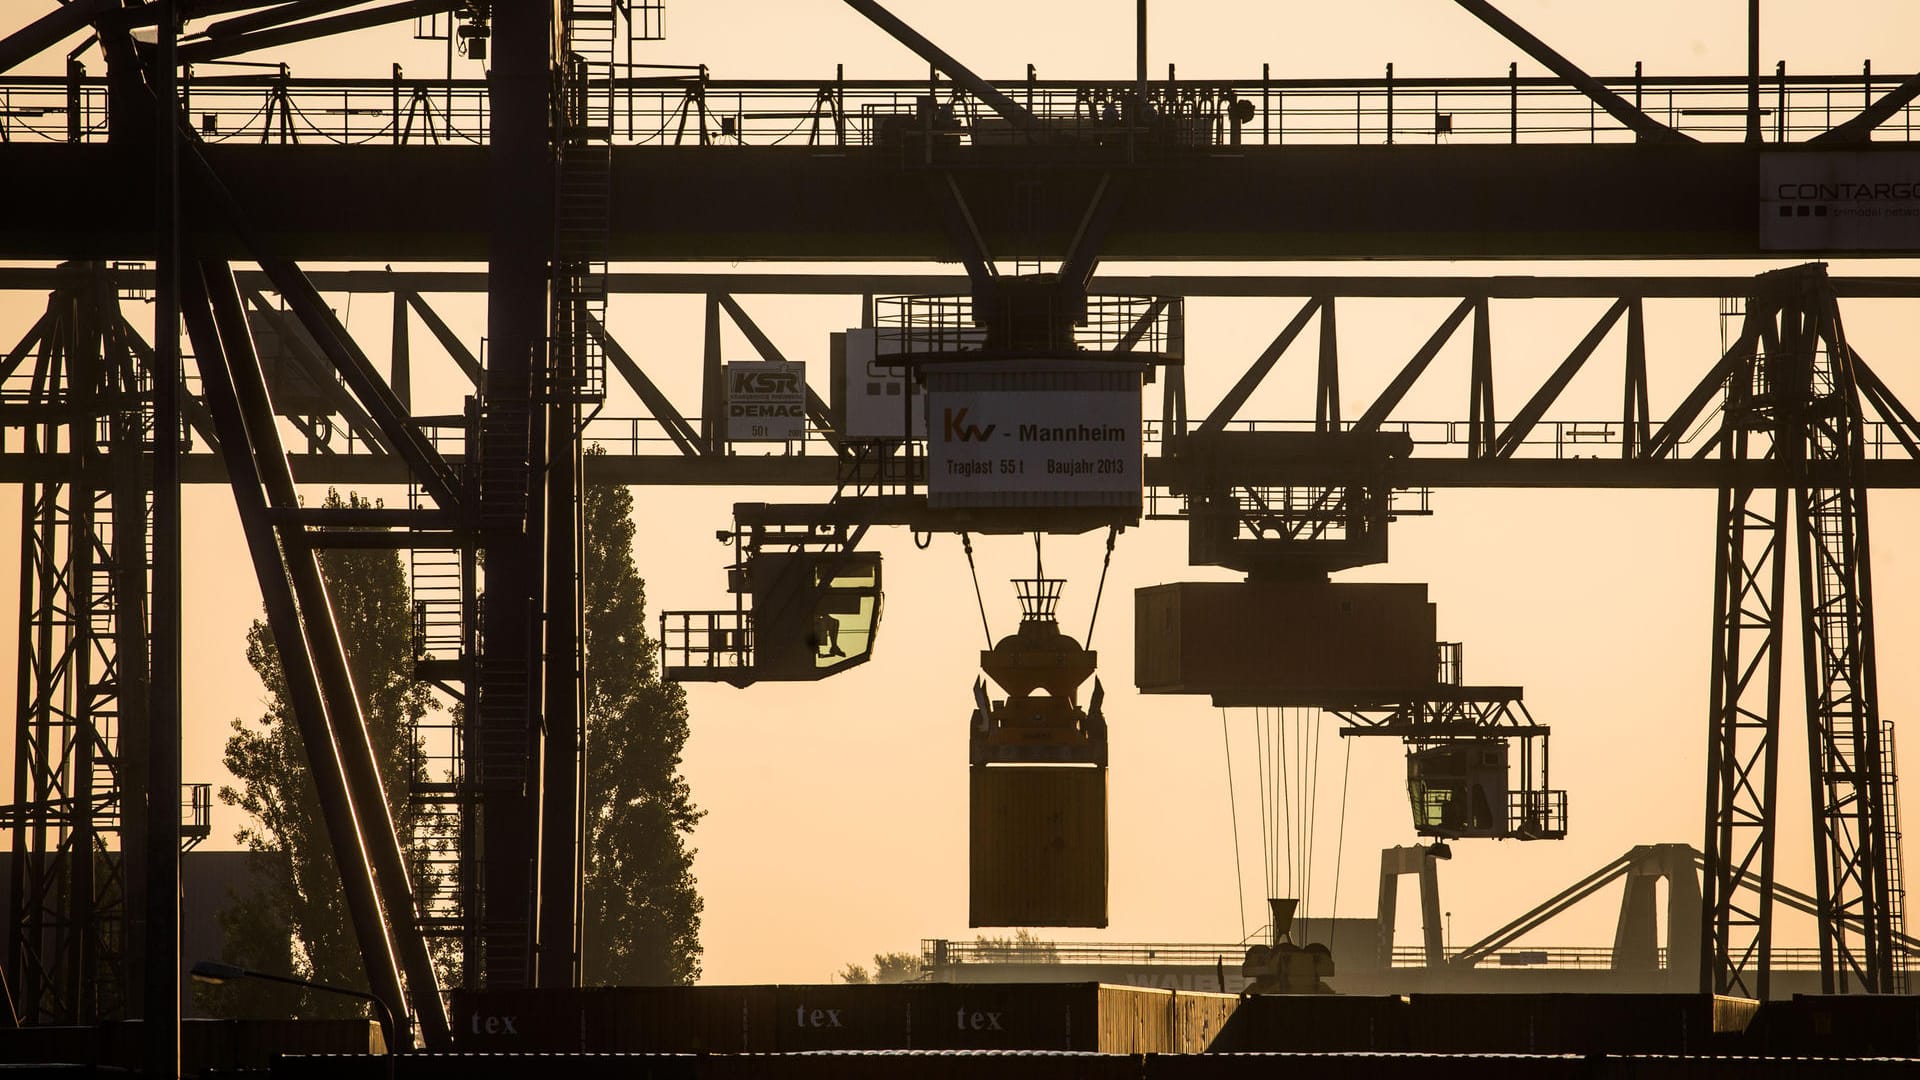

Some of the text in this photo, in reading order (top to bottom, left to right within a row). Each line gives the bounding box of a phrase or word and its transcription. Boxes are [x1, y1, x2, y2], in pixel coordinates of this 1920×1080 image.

[735, 373, 798, 393] KSR
[730, 405, 803, 417] DEMAG
[752, 425, 763, 437] 50
[1019, 424, 1126, 442] Mannheim
[946, 459, 1024, 477] Traglast 55 t
[1047, 459, 1124, 477] Baujahr 2013
[471, 1009, 518, 1035] tex
[796, 1003, 843, 1028] tex
[956, 1006, 1003, 1031] tex
